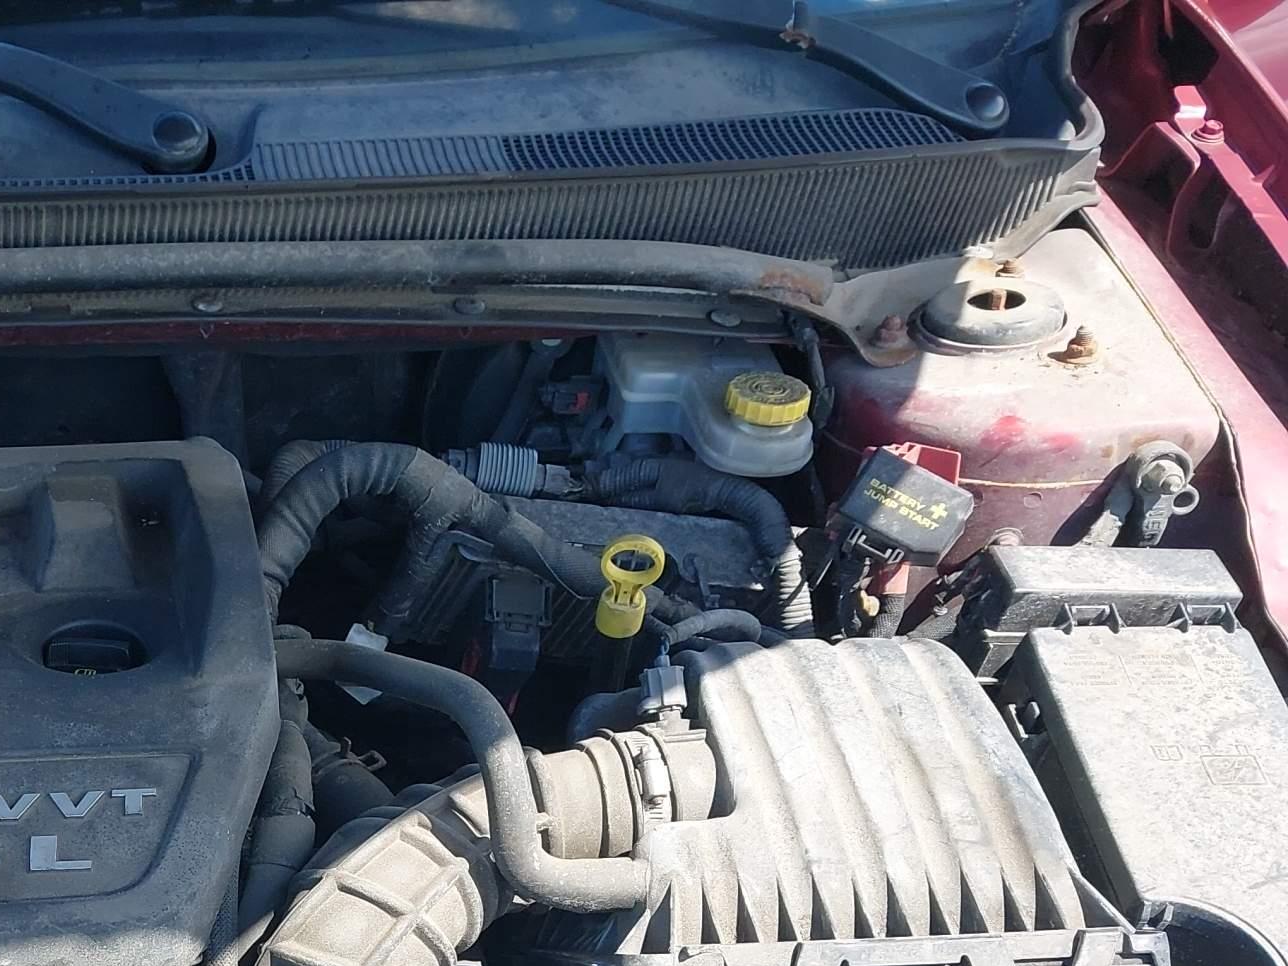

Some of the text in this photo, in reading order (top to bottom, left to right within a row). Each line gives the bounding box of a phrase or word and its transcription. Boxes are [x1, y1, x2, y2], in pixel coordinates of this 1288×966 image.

[864, 488, 940, 530] JUMP START
[870, 478, 926, 511] BATTERY
[29, 835, 93, 873] L
